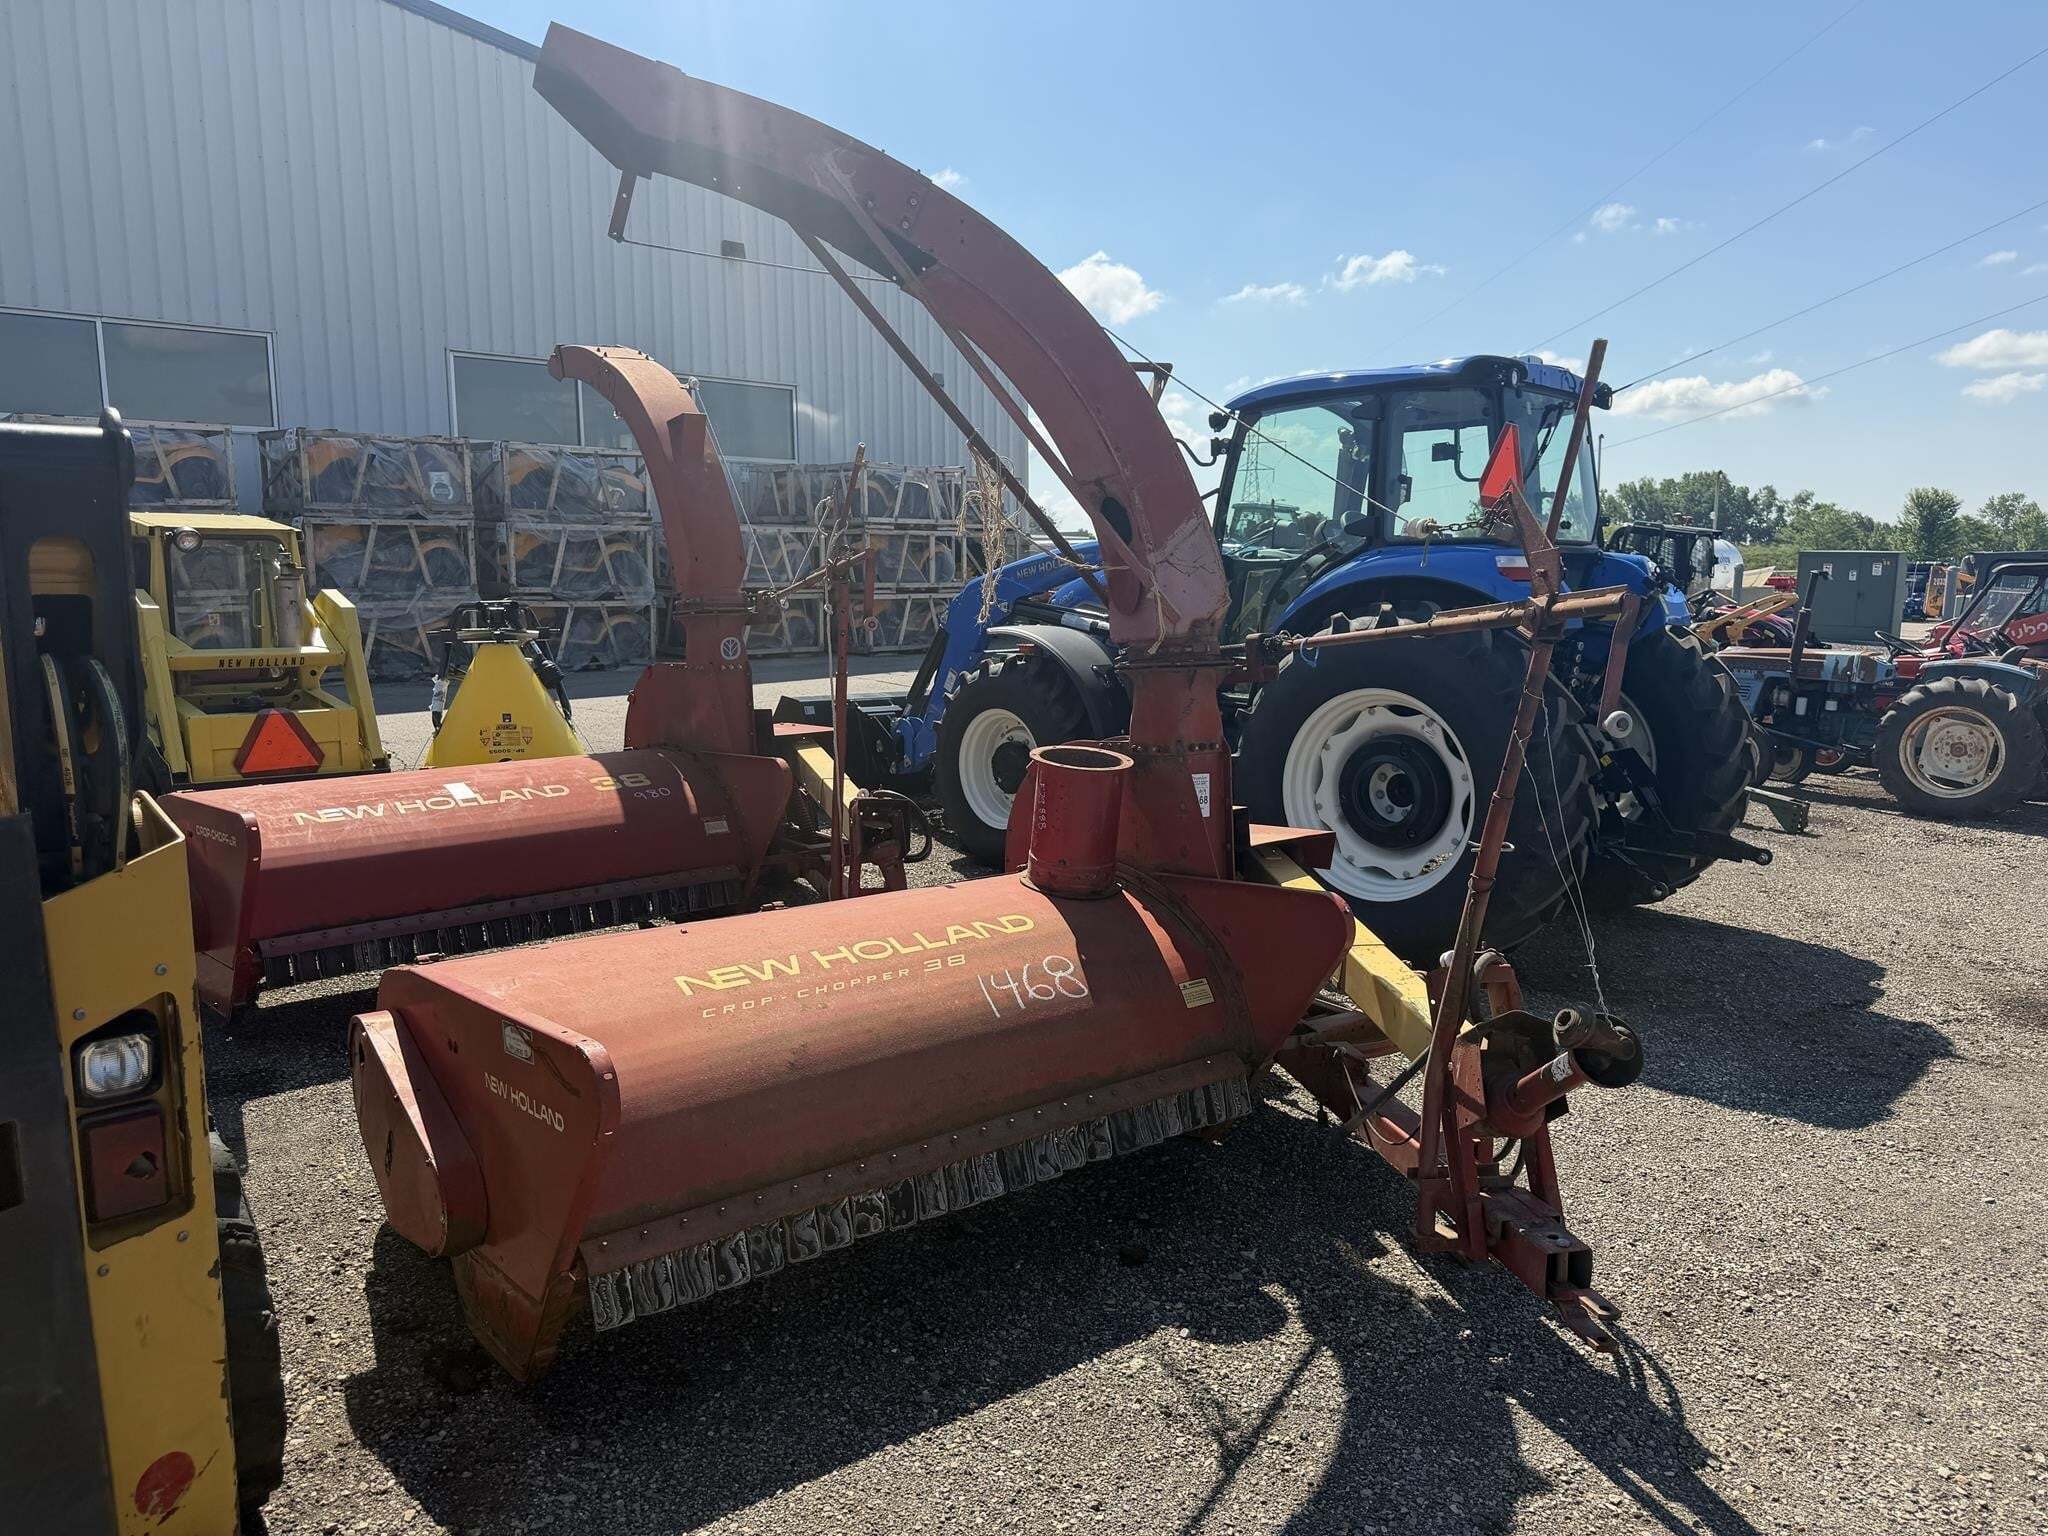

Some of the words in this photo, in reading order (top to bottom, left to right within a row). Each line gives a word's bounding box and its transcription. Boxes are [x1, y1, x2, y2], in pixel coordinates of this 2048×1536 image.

[1016, 566, 1037, 579] NEW
[219, 658, 242, 668] NEW
[249, 656, 305, 667] HOLLAND
[293, 803, 384, 826] NEW
[589, 773, 652, 791] 38
[673, 954, 801, 996] NEW
[810, 914, 1036, 969] HOLLAND
[923, 954, 966, 972] 38
[977, 955, 1088, 1018] 1468
[483, 1071, 508, 1099] NEW
[510, 1086, 565, 1132] HOLLAND
